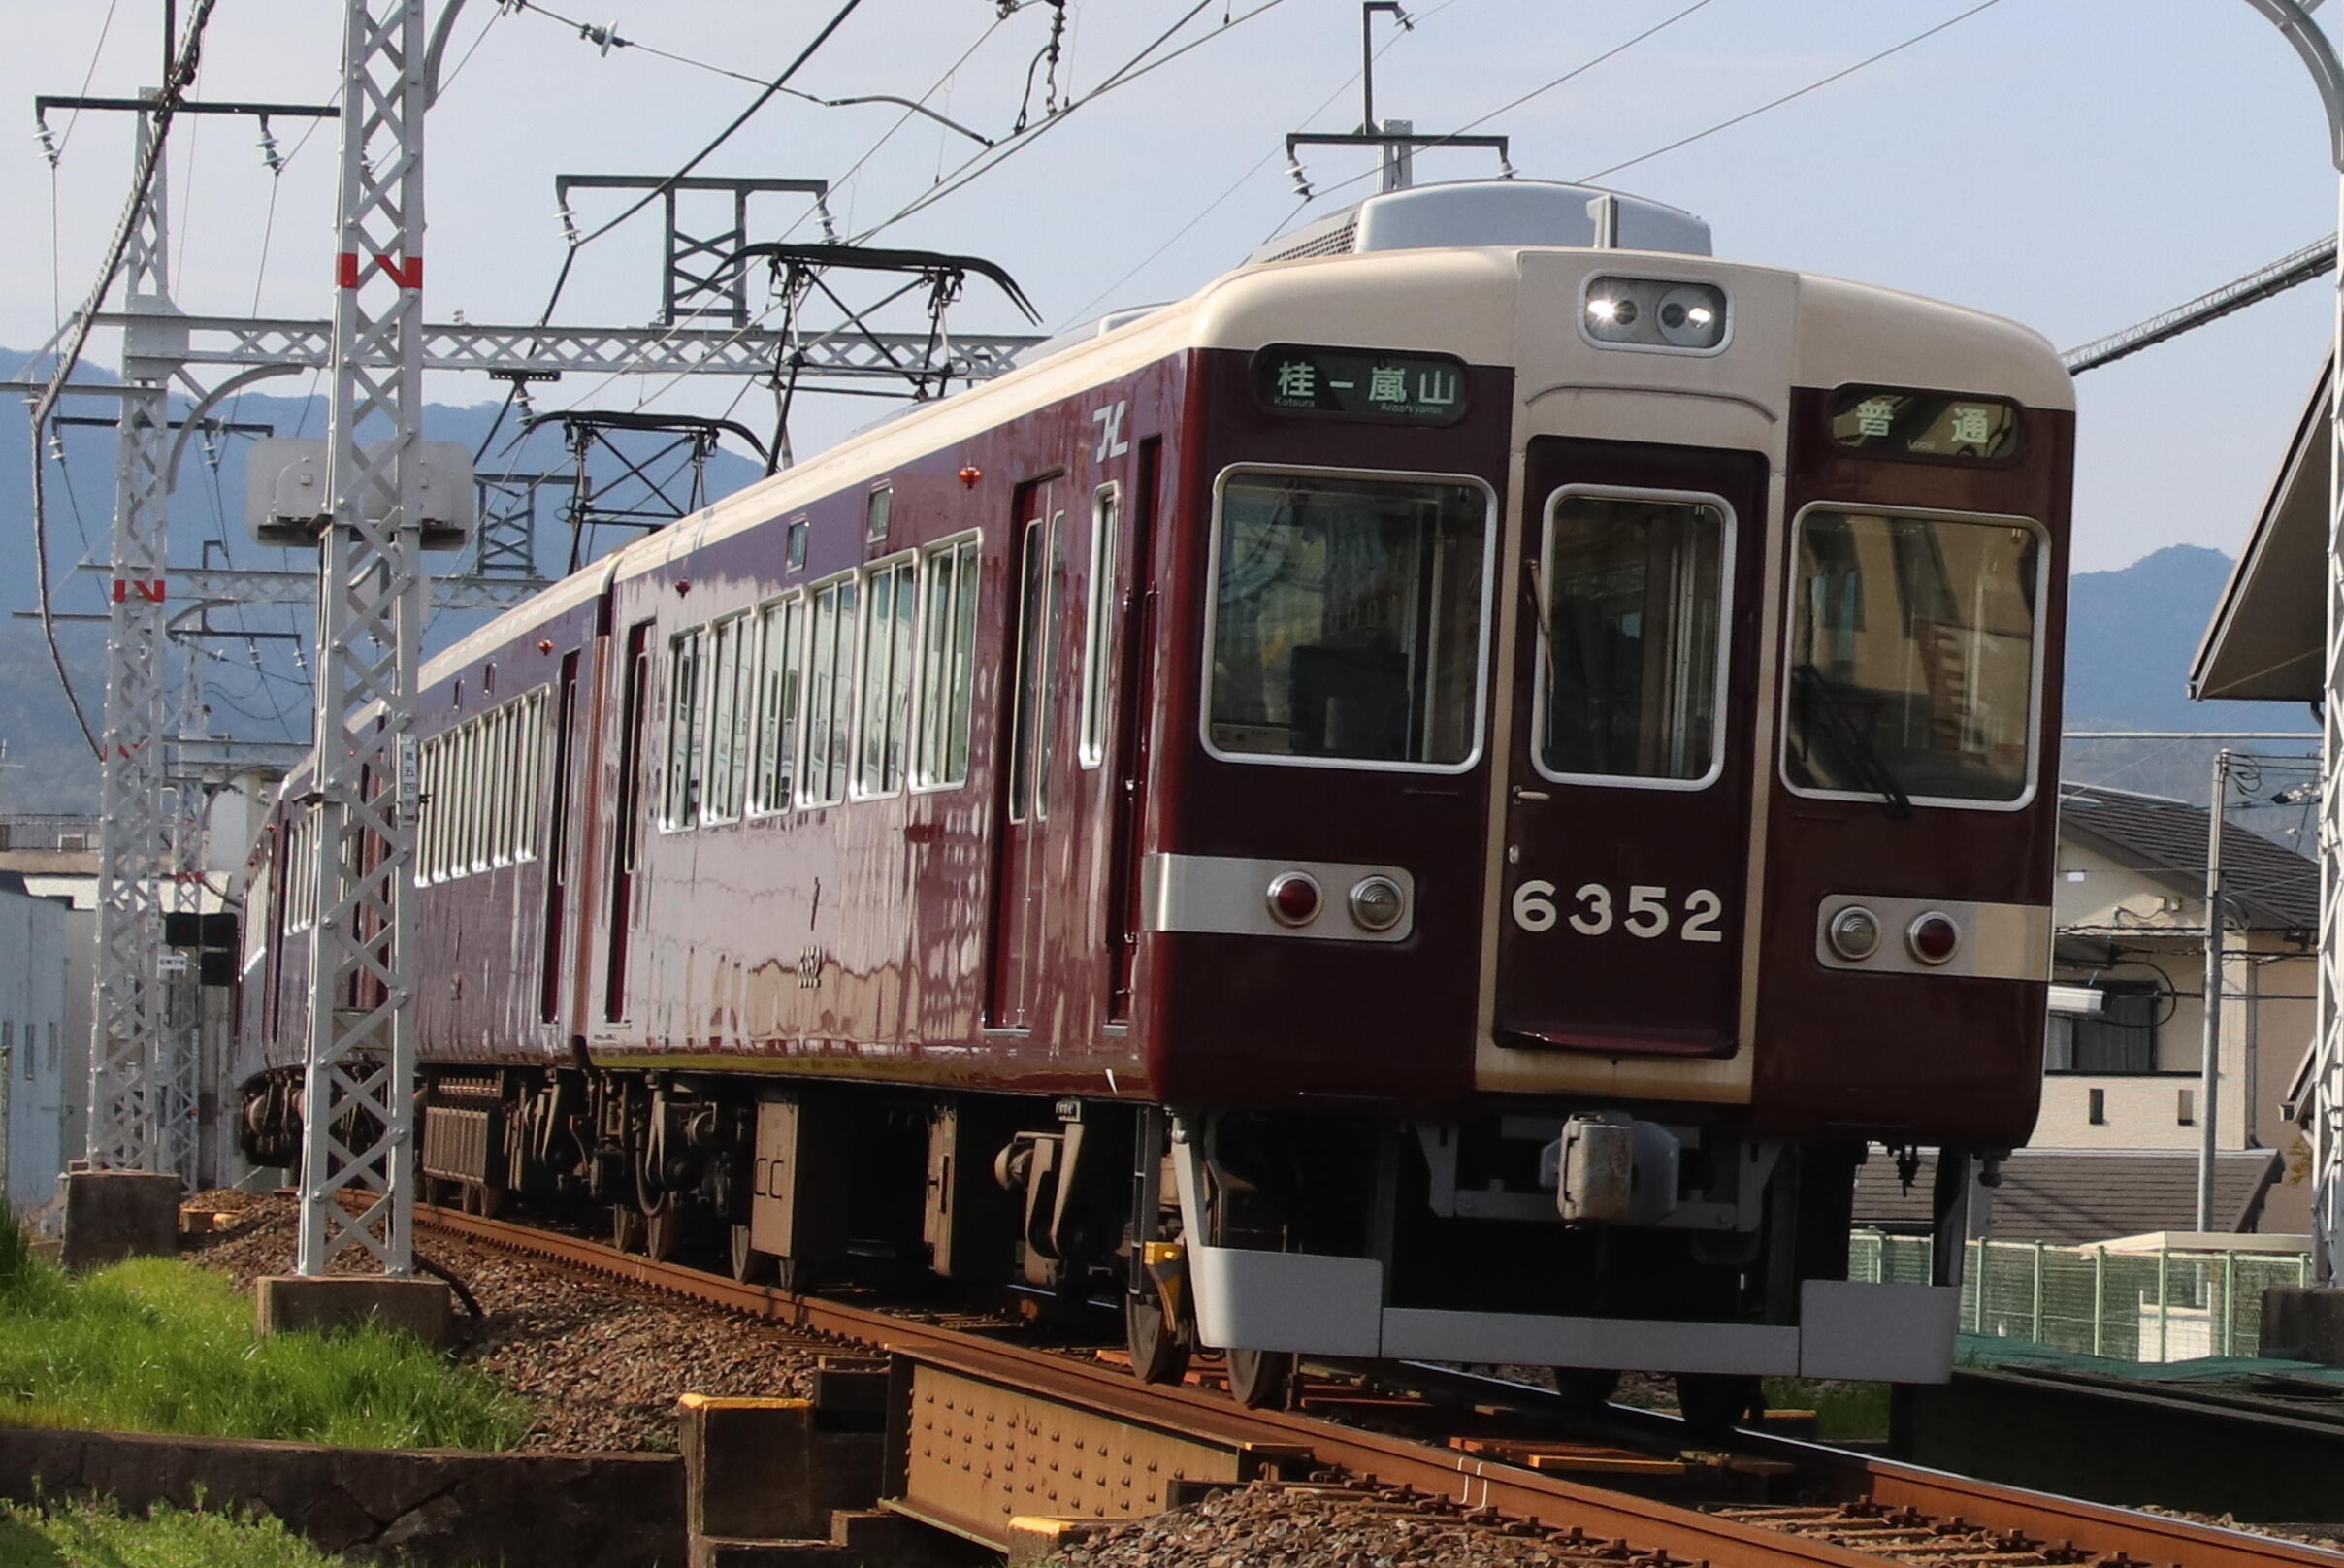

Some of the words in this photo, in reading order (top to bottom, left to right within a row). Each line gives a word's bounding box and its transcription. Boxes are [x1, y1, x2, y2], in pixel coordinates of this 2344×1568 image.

[1273, 396, 1316, 408] Katsura
[1380, 401, 1443, 416] Arashiyama
[1856, 400, 1989, 444] 普通
[1512, 879, 1722, 943] 6352
